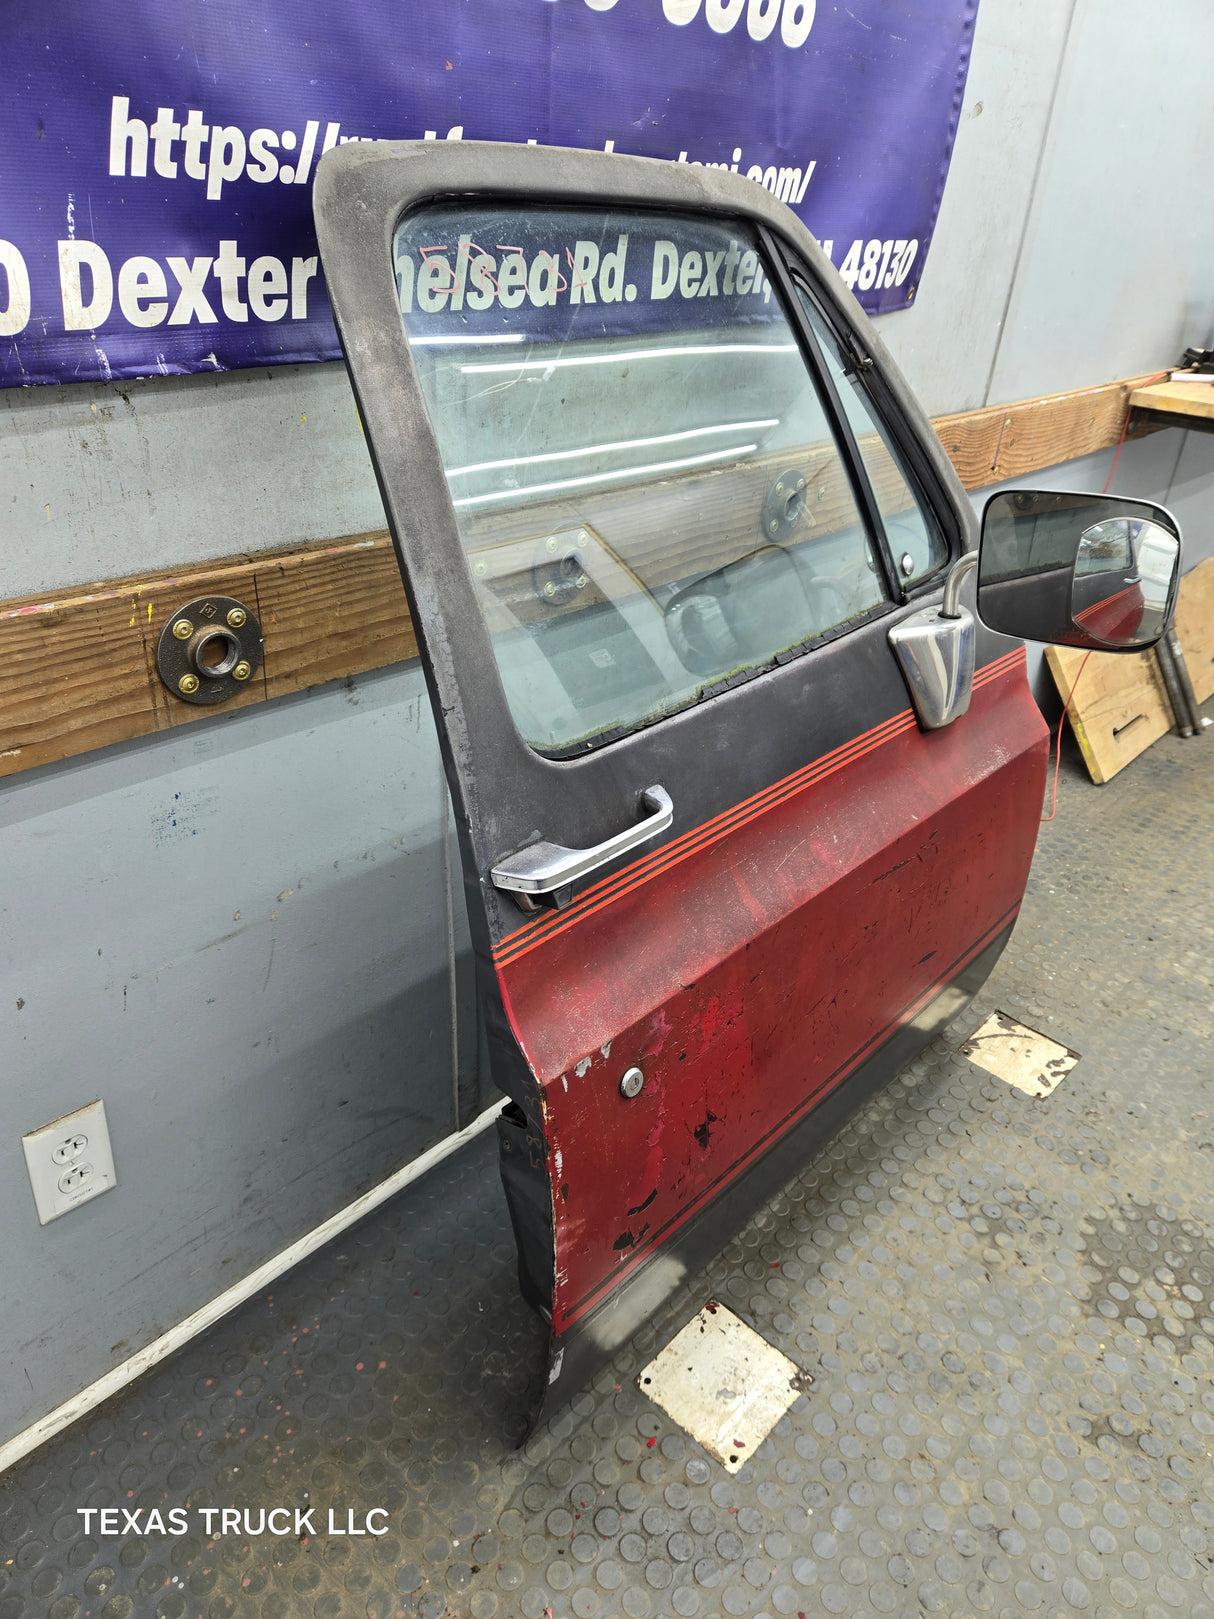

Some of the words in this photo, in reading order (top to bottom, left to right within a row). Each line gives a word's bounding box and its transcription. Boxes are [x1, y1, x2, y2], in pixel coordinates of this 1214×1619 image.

[57, 239, 319, 331] Dexter
[393, 233, 560, 314] helsea
[569, 233, 638, 305] Rd.
[838, 238, 919, 291] 48130
[419, 240, 588, 296] 58731
